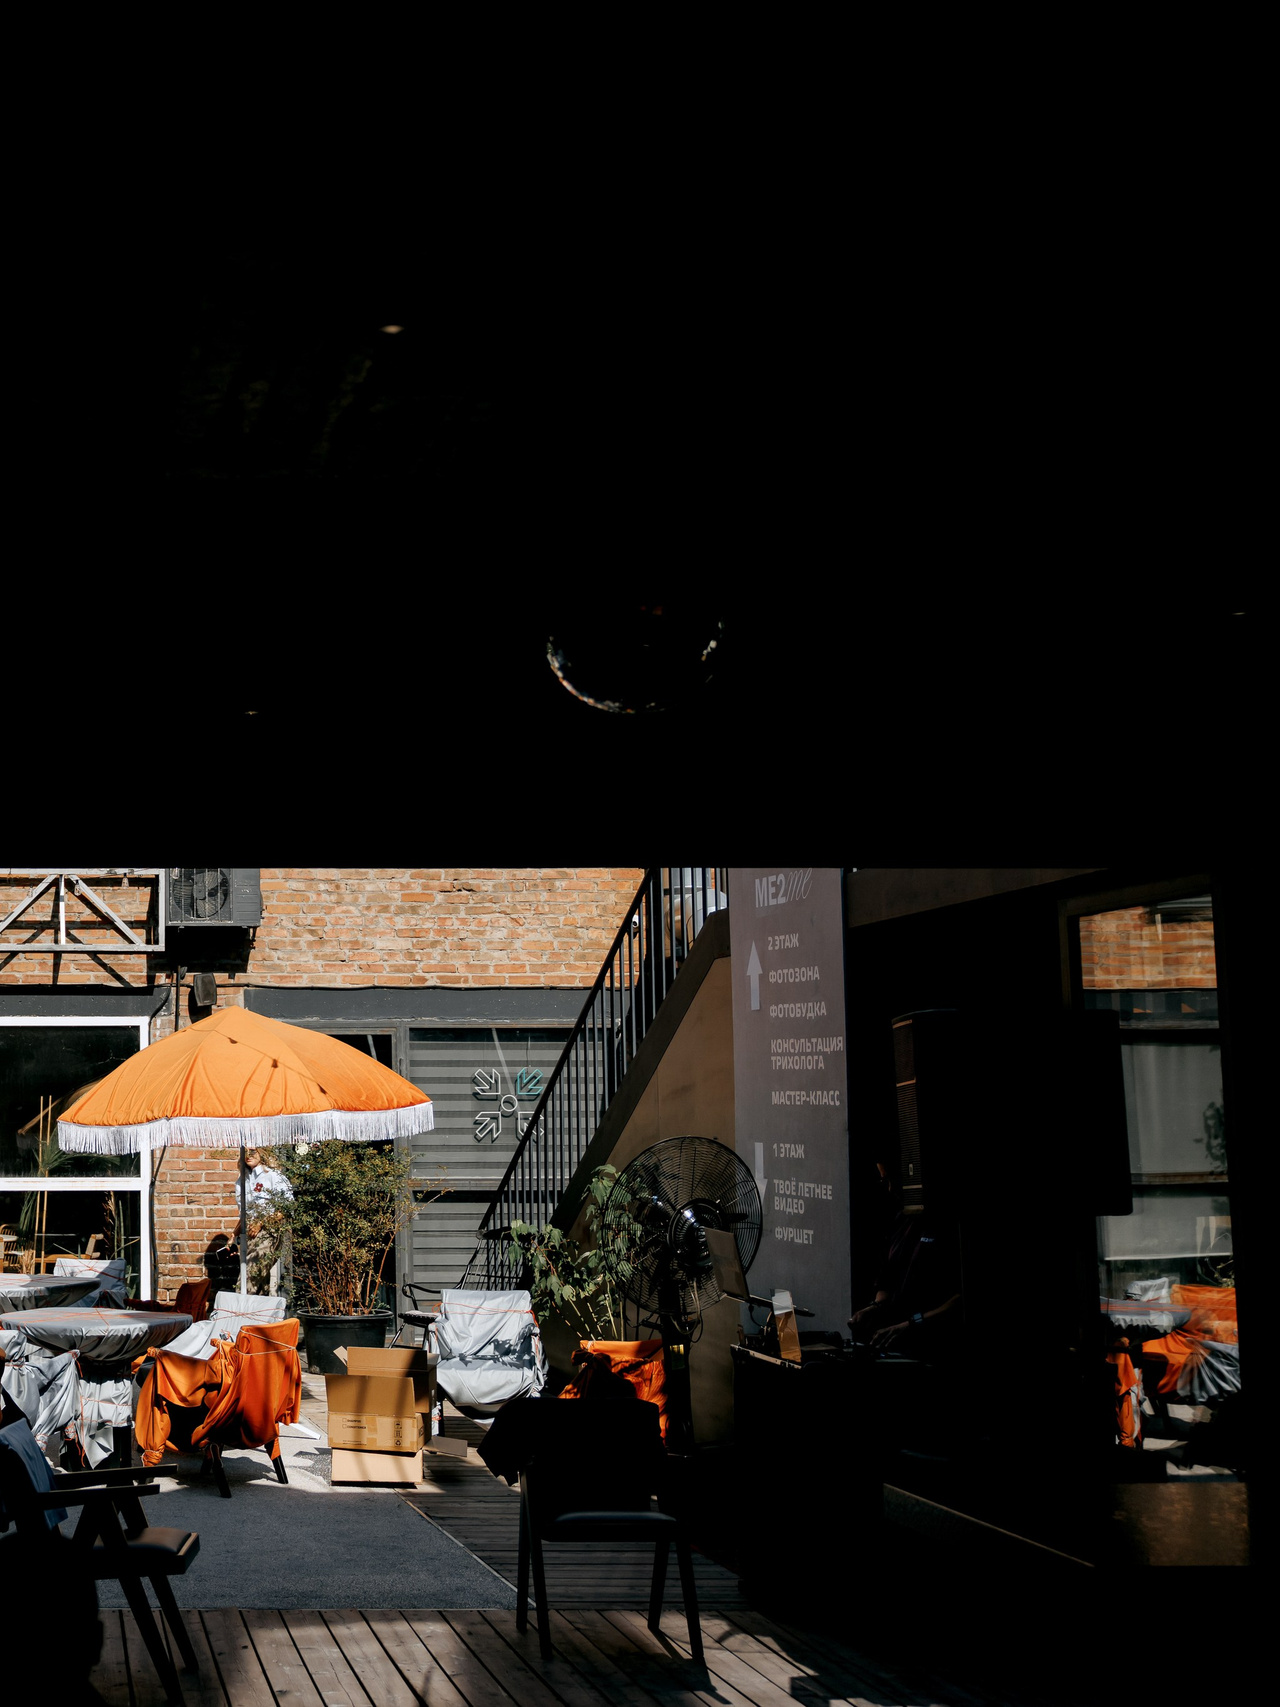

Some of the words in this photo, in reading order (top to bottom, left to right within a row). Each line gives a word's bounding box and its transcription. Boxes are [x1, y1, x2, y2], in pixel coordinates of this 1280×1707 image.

[768, 936, 773, 951] 2
[775, 933, 799, 949] ЭТАЖ
[769, 966, 820, 983] ФОТОЗОНА
[770, 1001, 827, 1020] ФОТОБУДКА
[771, 1036, 843, 1054] КОНСУЛЬТАЦИЯ
[771, 1055, 824, 1070] ТРИХОЛОГА
[771, 1090, 840, 1106] МАСТЕР-КЛАСС
[773, 1143, 777, 1157] 1
[780, 1143, 805, 1158] ЭТАЖ
[774, 1178, 796, 1195] ТВОЁ
[797, 1182, 833, 1200] ЛЕТНЕЕ
[774, 1197, 805, 1215] ВИДЕО
[775, 1226, 814, 1245] ФУРШЕТ
